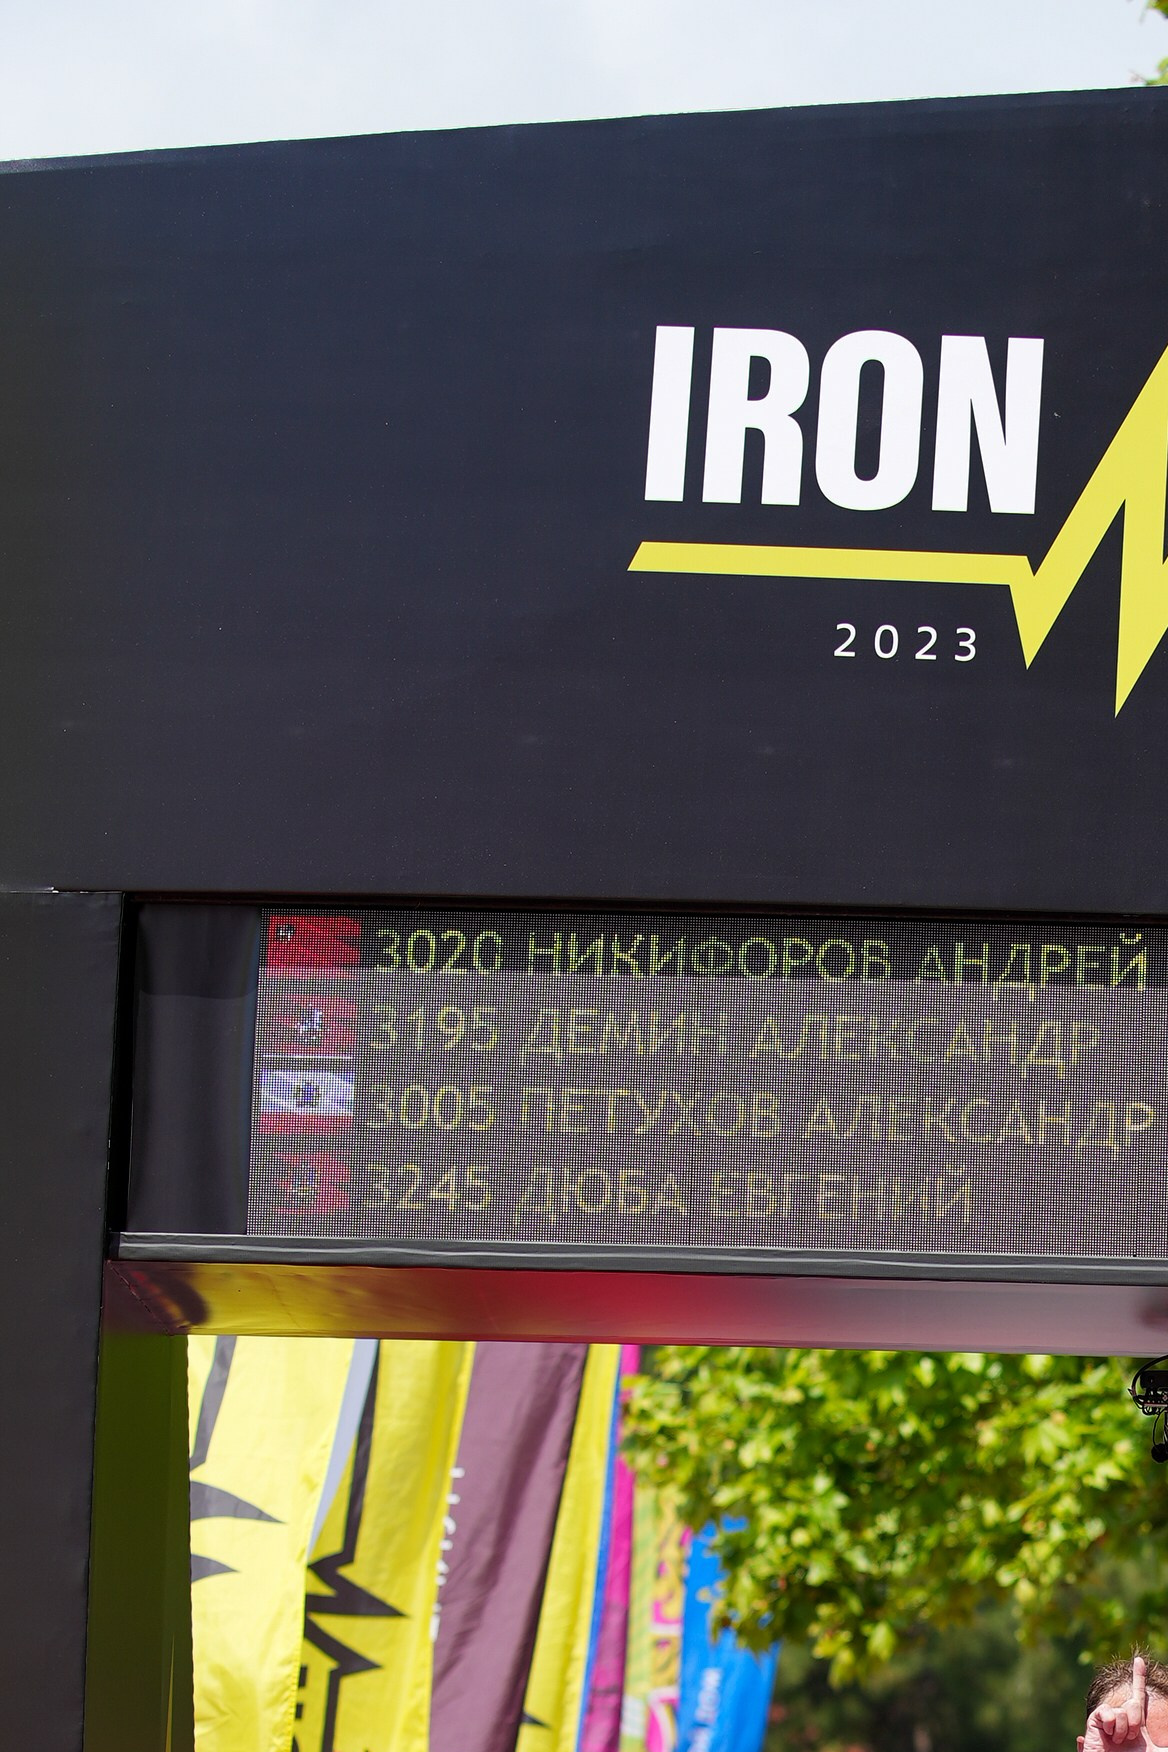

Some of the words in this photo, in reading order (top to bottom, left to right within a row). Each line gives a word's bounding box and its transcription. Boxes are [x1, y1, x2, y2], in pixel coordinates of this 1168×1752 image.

[643, 324, 1045, 515] IRON
[833, 622, 980, 663] 2023
[374, 929, 503, 976] 3020
[527, 931, 892, 984] НИКИФОРОВ
[914, 932, 1148, 1003] АНДРЕЙ
[370, 1004, 499, 1052] 3195
[520, 1007, 729, 1066] ДЕМИН
[749, 1012, 1102, 1080] АЛЕКСАНДР
[366, 1083, 498, 1132] 3005
[520, 1086, 783, 1139] ПЕТУХОВ
[801, 1093, 1156, 1161] АЛЕКСАНДР
[364, 1162, 494, 1211] 3245
[514, 1166, 687, 1228] ДЮБА
[710, 1164, 976, 1223] ЕВГЕНИЙ
